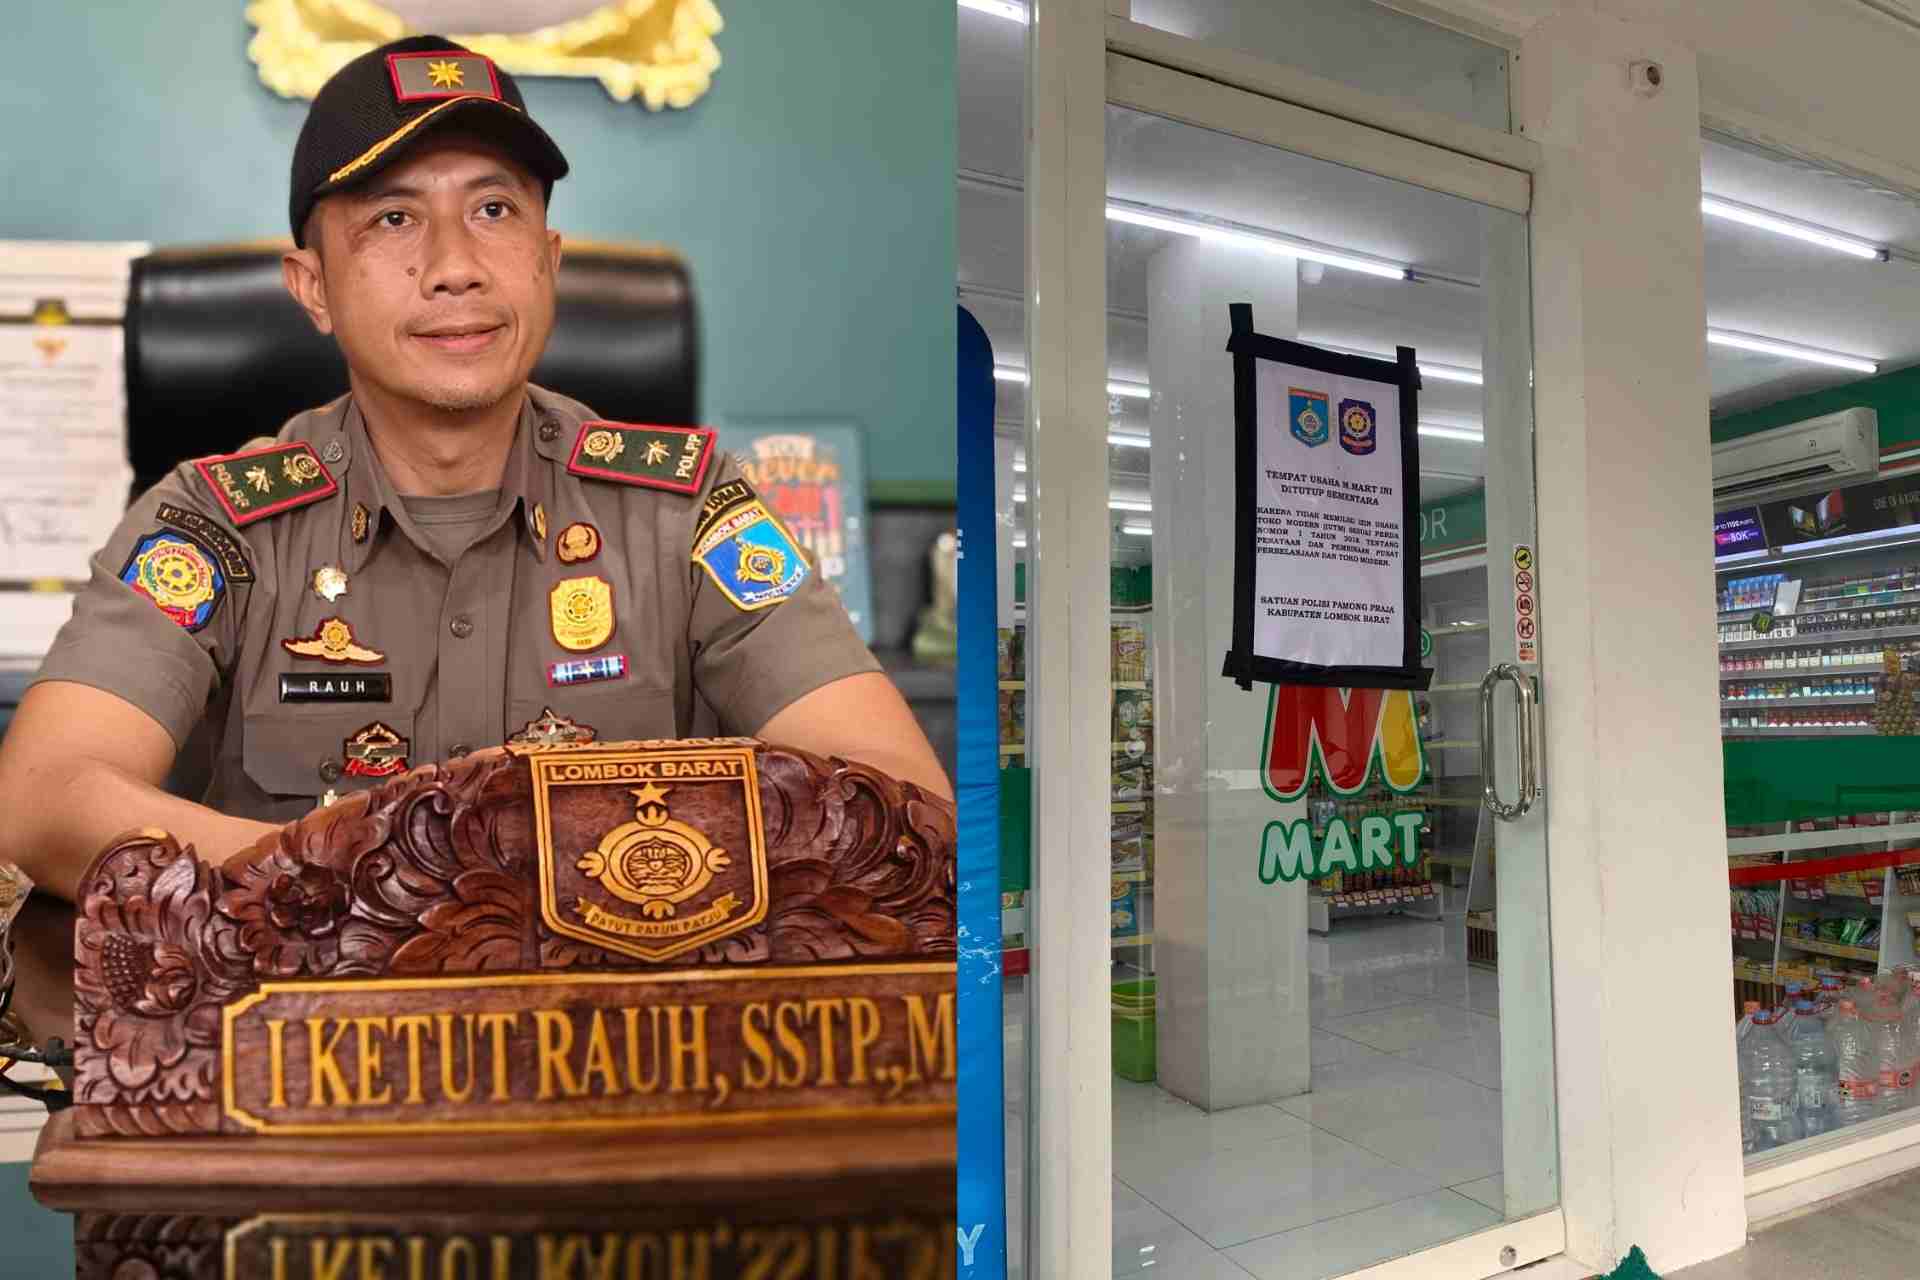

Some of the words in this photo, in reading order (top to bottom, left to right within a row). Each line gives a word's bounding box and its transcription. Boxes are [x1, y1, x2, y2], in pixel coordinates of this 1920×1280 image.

[1265, 470, 1308, 483] TEMPAT
[1310, 476, 1341, 488] USAHA
[1380, 486, 1393, 496] INI
[1281, 484, 1325, 497] DITUTUP
[1326, 490, 1380, 506] SEMENTARA
[1257, 506, 1292, 516] KARENA
[1296, 510, 1320, 519] TIDAK
[1375, 521, 1399, 530] USAHA
[1257, 517, 1281, 526] TOKO
[1286, 519, 1320, 530] MODERN
[1375, 530, 1399, 539] PERDA
[1257, 527, 1288, 535] NOMOR
[1311, 532, 1336, 540] TAHUN
[1366, 538, 1399, 549] TENTANG
[1257, 537, 1301, 546] PENATAAN
[1308, 541, 1324, 549] DAN
[1375, 550, 1399, 558] PUSAT
[1257, 546, 1320, 559] PERBELANJAAN
[1322, 551, 1337, 560] DAN
[1339, 554, 1359, 563] TOKO
[1260, 596, 1299, 606] SATUAN
[1301, 599, 1330, 608] POLISI
[1332, 601, 1368, 611] PAMONG
[1370, 604, 1395, 614] PRAJA
[1267, 608, 1322, 619] KABUPATEN
[1323, 612, 1361, 622] LOMBOK
[1362, 614, 1391, 624] BARAT
[309, 681, 365, 692] RAUH
[550, 762, 656, 781] LOMBOK
[661, 760, 740, 777] BARAT
[1259, 810, 1424, 885] MART
[265, 1019, 288, 1109] I
[304, 1012, 518, 1107] KETUT
[534, 1003, 729, 1105] RAUH,
